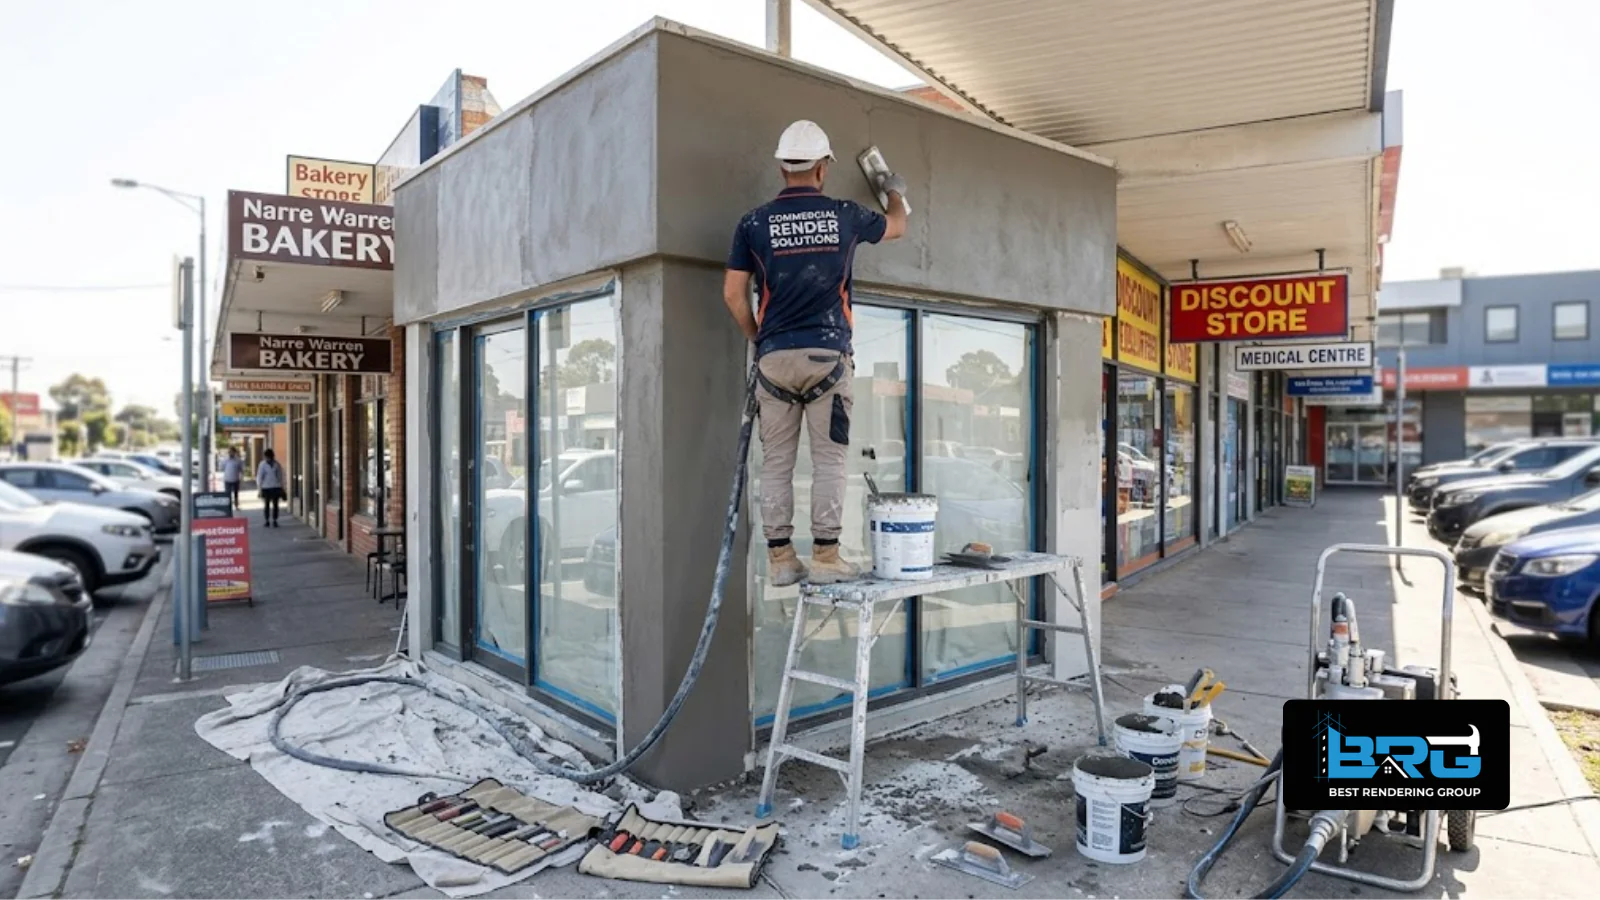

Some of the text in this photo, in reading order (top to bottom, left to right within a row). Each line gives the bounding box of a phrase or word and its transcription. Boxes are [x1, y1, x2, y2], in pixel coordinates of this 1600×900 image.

[296, 163, 368, 190] Bakery
[243, 198, 314, 223] Narre
[769, 220, 839, 237] RENDER
[771, 233, 840, 248] SOLUTIONS
[1181, 280, 1336, 311] DISCOUNT
[1206, 308, 1308, 336] STORE
[259, 336, 364, 351] Narre Warren
[259, 350, 365, 370] BAKERY
[1241, 347, 1366, 365] MEDICAL CENTRE
